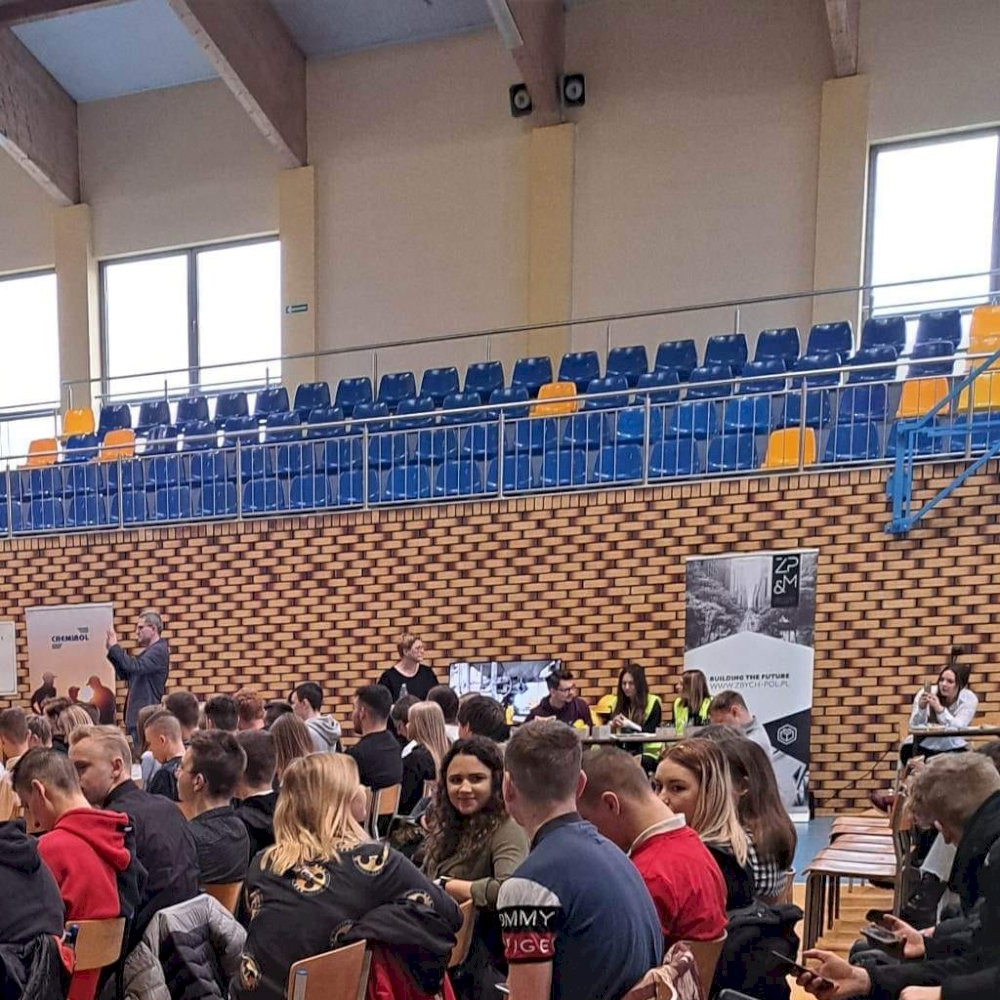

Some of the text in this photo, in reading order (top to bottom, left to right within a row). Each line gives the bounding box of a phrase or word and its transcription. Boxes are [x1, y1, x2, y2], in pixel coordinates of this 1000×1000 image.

[709, 671, 790, 682] BUILDING THE FUTURE
